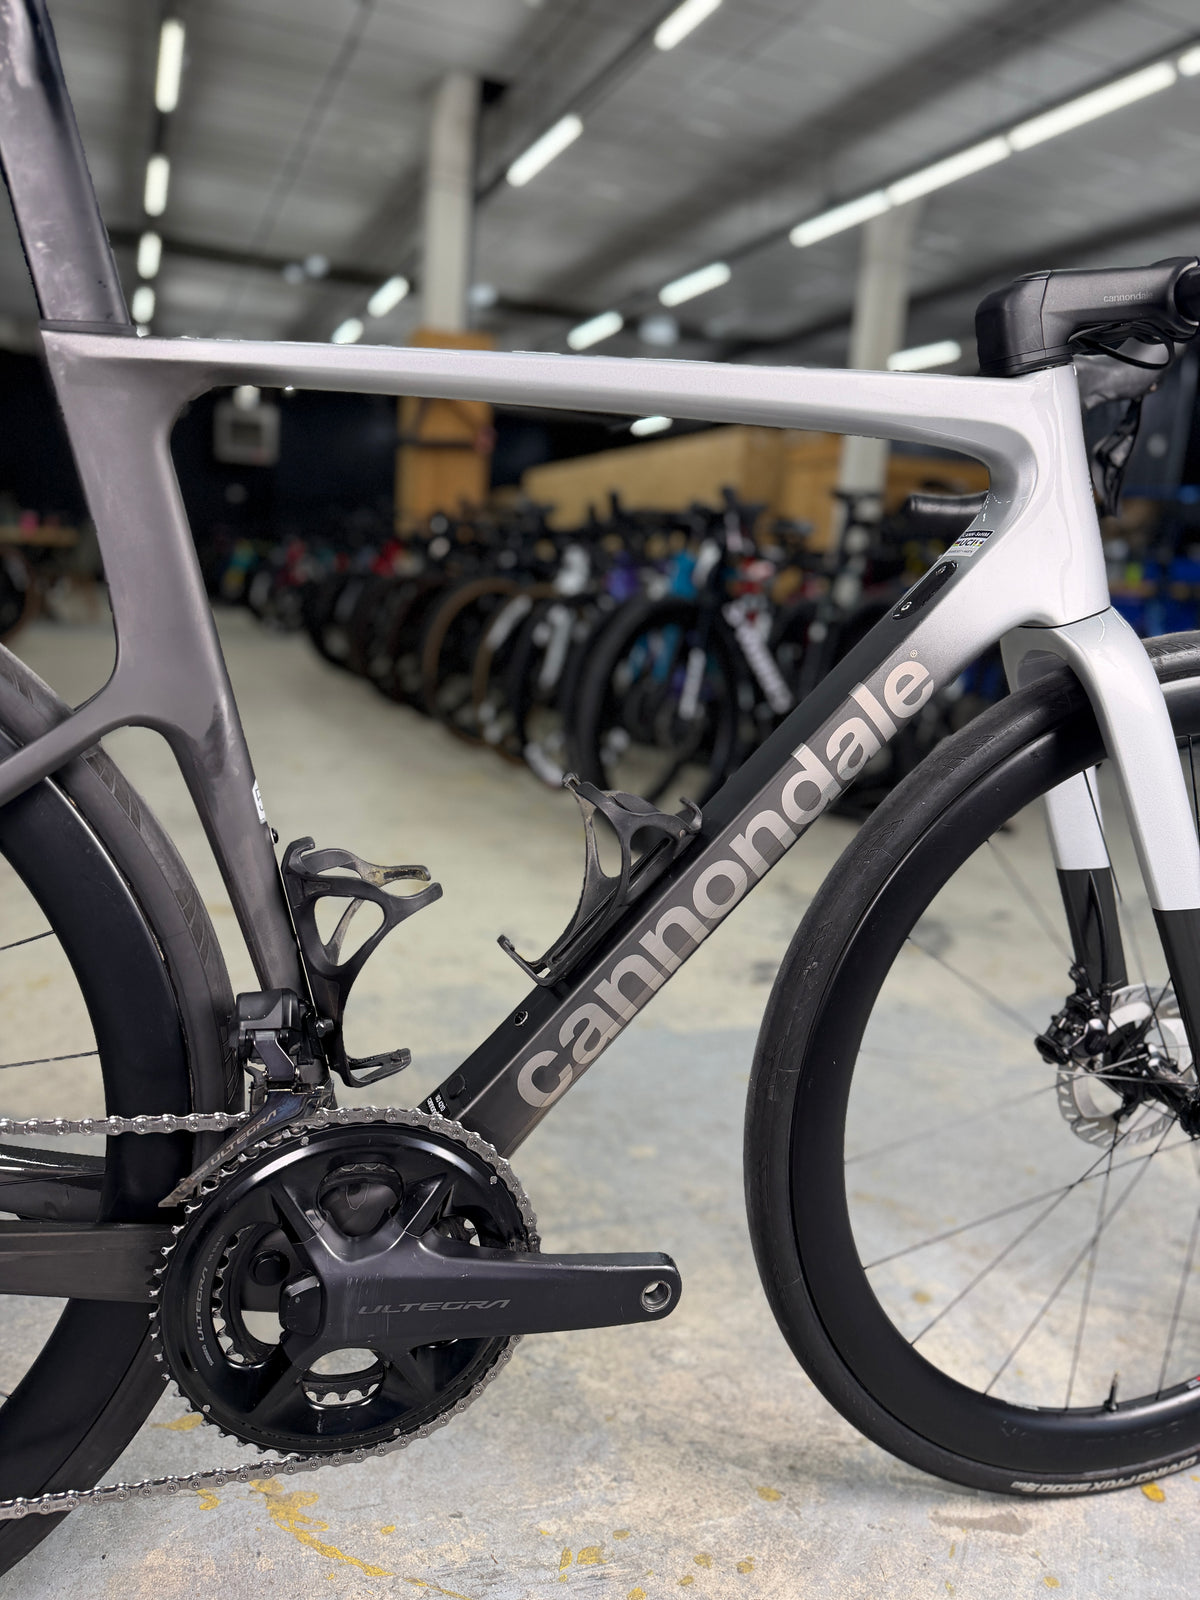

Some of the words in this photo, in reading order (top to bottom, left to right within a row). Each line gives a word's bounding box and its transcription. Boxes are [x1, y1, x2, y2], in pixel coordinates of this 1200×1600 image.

[1103, 291, 1153, 303] cannondale
[210, 1109, 277, 1166] ULTEGRA
[194, 1267, 208, 1342] ULTEGRA
[358, 1299, 511, 1315] ULTEGRA
